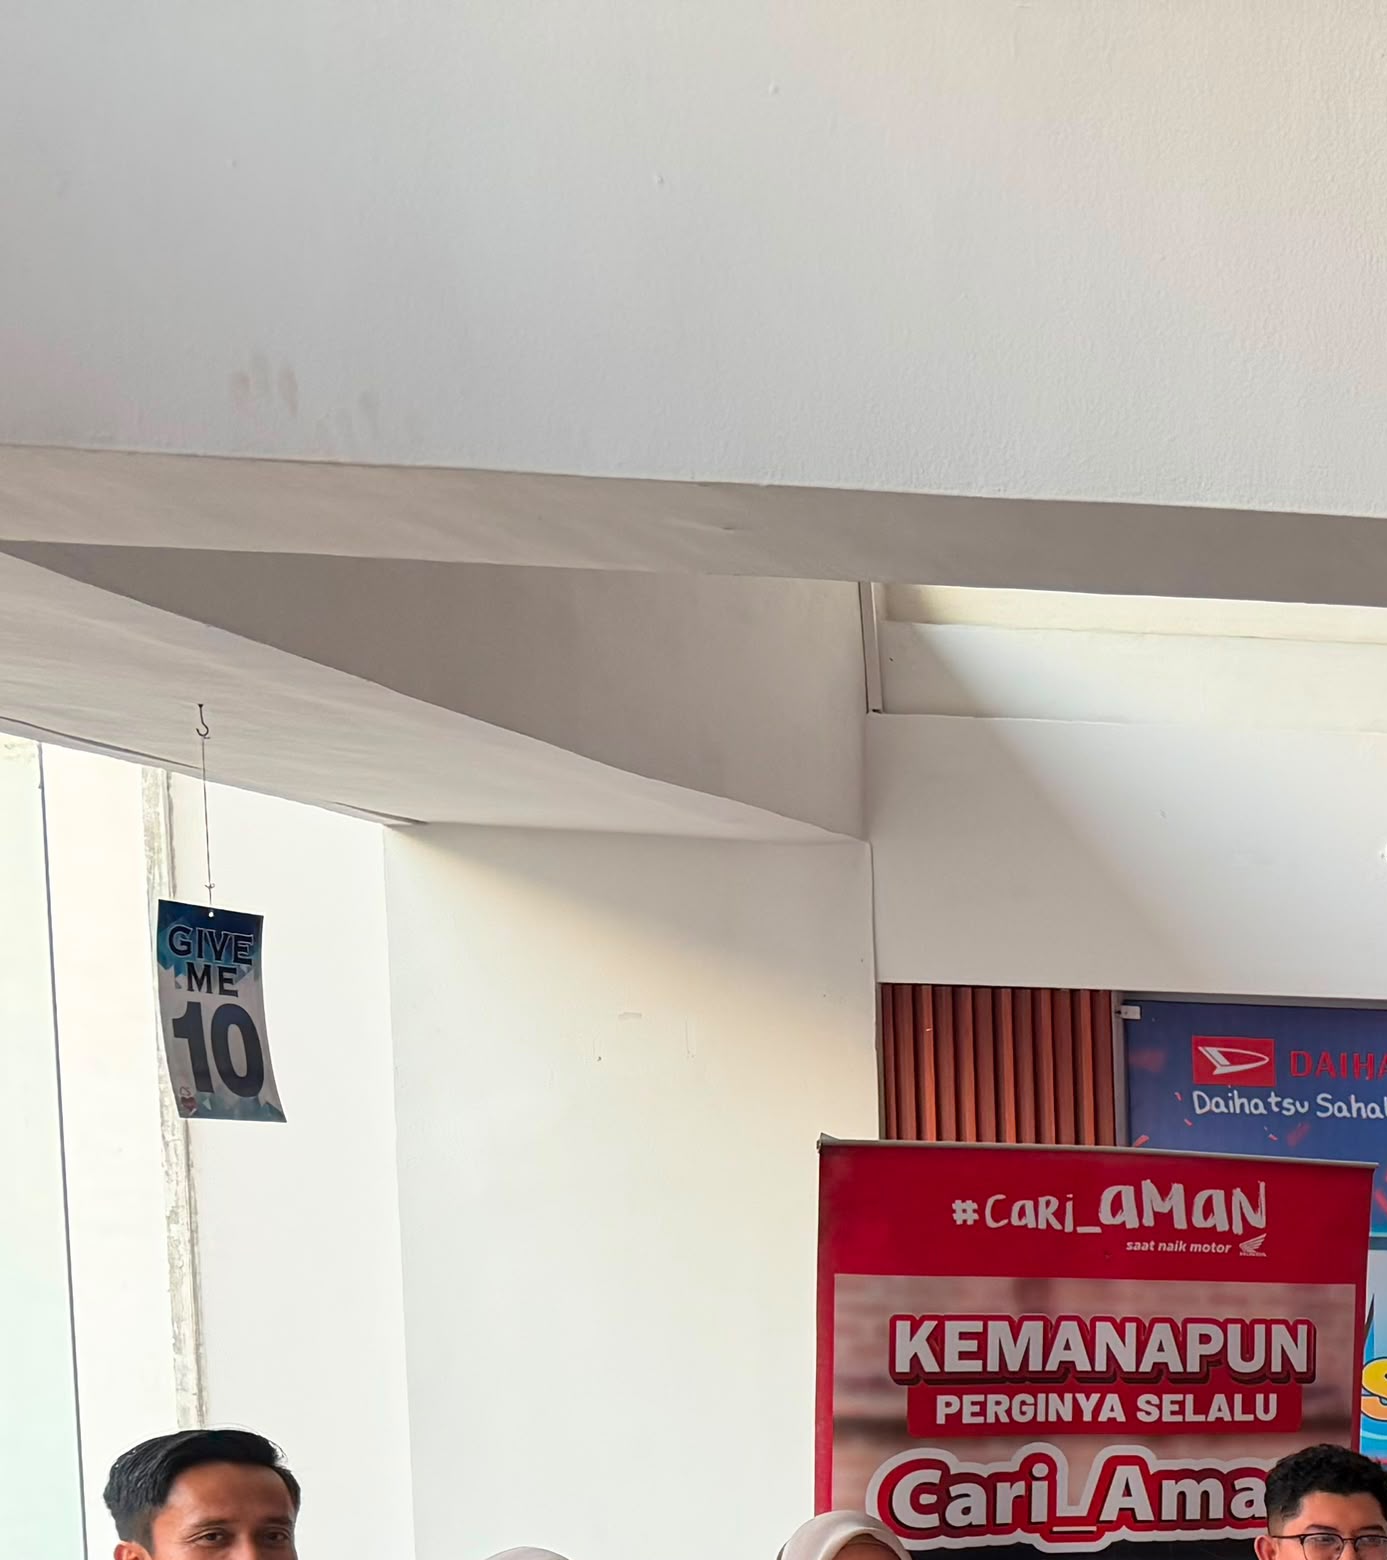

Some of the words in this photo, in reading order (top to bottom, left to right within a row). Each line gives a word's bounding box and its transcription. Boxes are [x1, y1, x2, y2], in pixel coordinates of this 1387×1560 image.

[167, 924, 254, 966] GIVE
[186, 961, 239, 998] ME
[171, 1001, 265, 1098] 10
[1192, 1090, 1309, 1116] Daihatsu
[1125, 1240, 1155, 1251] saat
[1157, 1239, 1187, 1252] naik
[1189, 1241, 1232, 1254] motor
[893, 1319, 1309, 1375] KEMANAPUN
[935, 1393, 1128, 1425] PERGINYA
[1135, 1392, 1279, 1423] SELALU
[891, 1462, 1267, 1534] Cari_Ama
